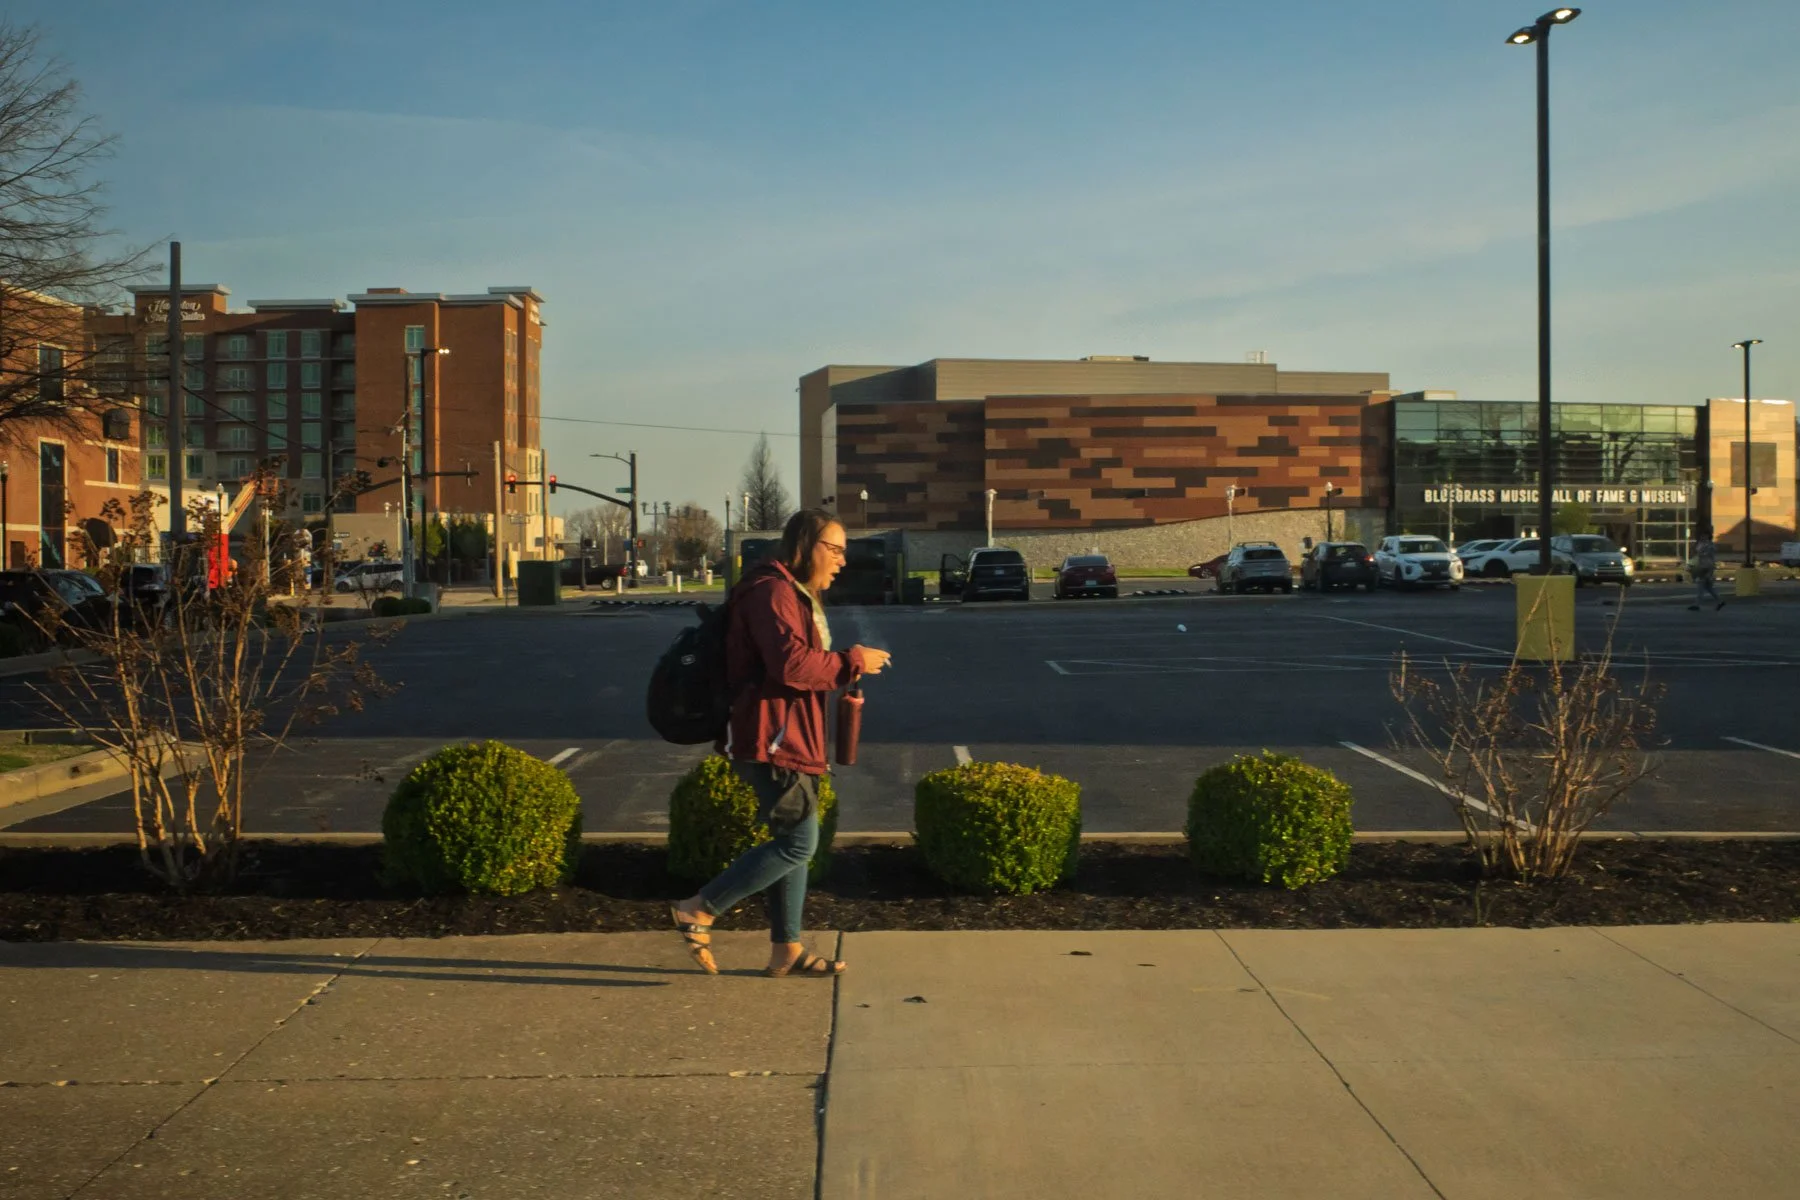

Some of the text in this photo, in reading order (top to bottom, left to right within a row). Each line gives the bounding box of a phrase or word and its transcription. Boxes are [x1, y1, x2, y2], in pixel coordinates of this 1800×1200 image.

[1500, 489, 1539, 502] MUSIC
[1550, 489, 1572, 502] ALL
[1577, 489, 1591, 502] OF
[1596, 489, 1625, 502] FAME
[1641, 489, 1686, 502] MUSEUM
